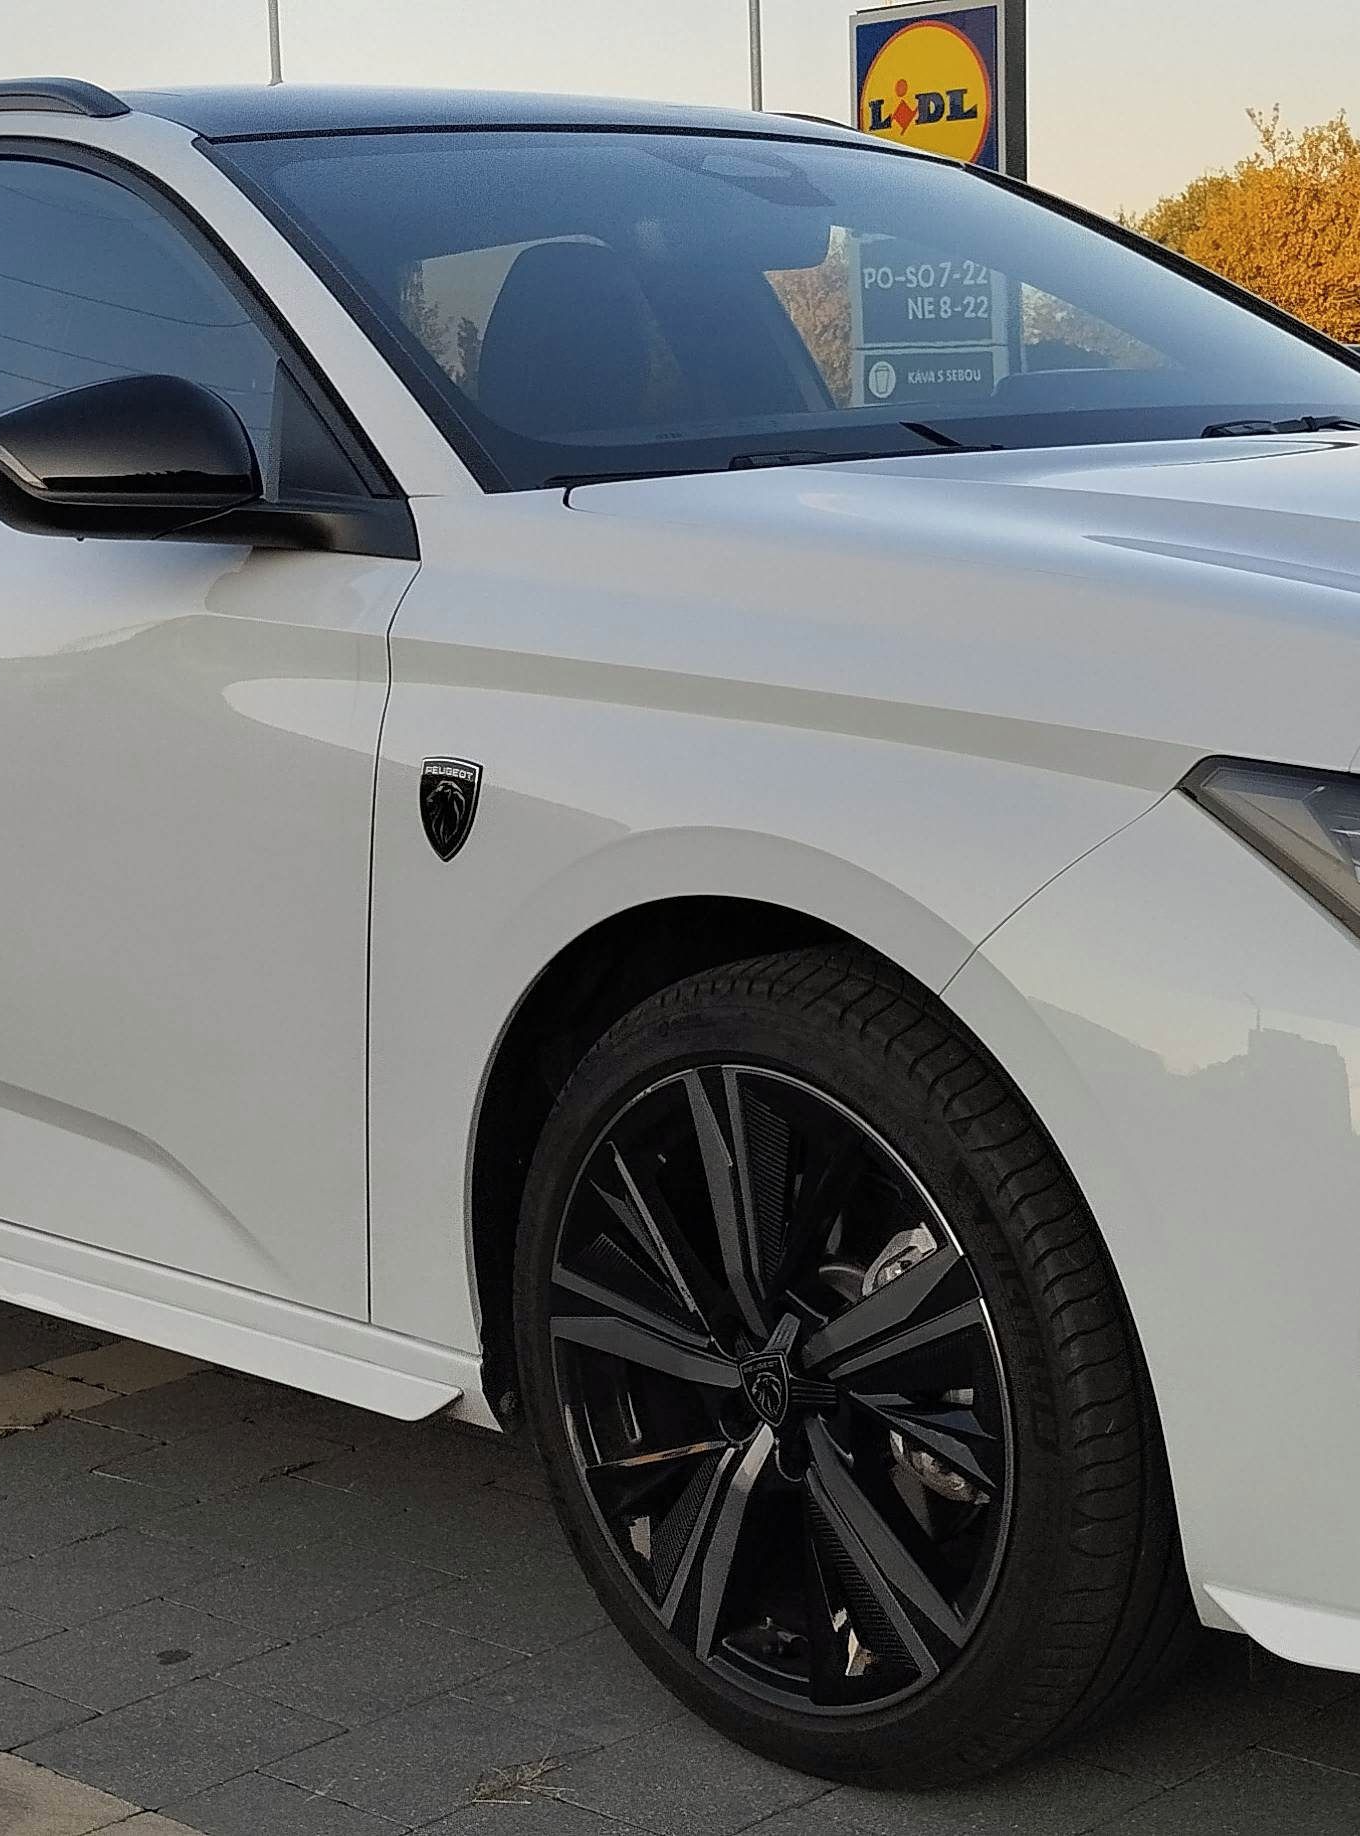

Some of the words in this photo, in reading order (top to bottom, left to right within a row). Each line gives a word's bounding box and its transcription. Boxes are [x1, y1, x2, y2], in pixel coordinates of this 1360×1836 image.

[863, 264, 935, 289] PO-SO
[939, 259, 989, 288] 7-22
[907, 297, 936, 320] NE
[939, 296, 989, 319] 8-22
[937, 369, 944, 383] S
[945, 368, 981, 383] SEBOU
[425, 765, 474, 782] PEUGEOT
